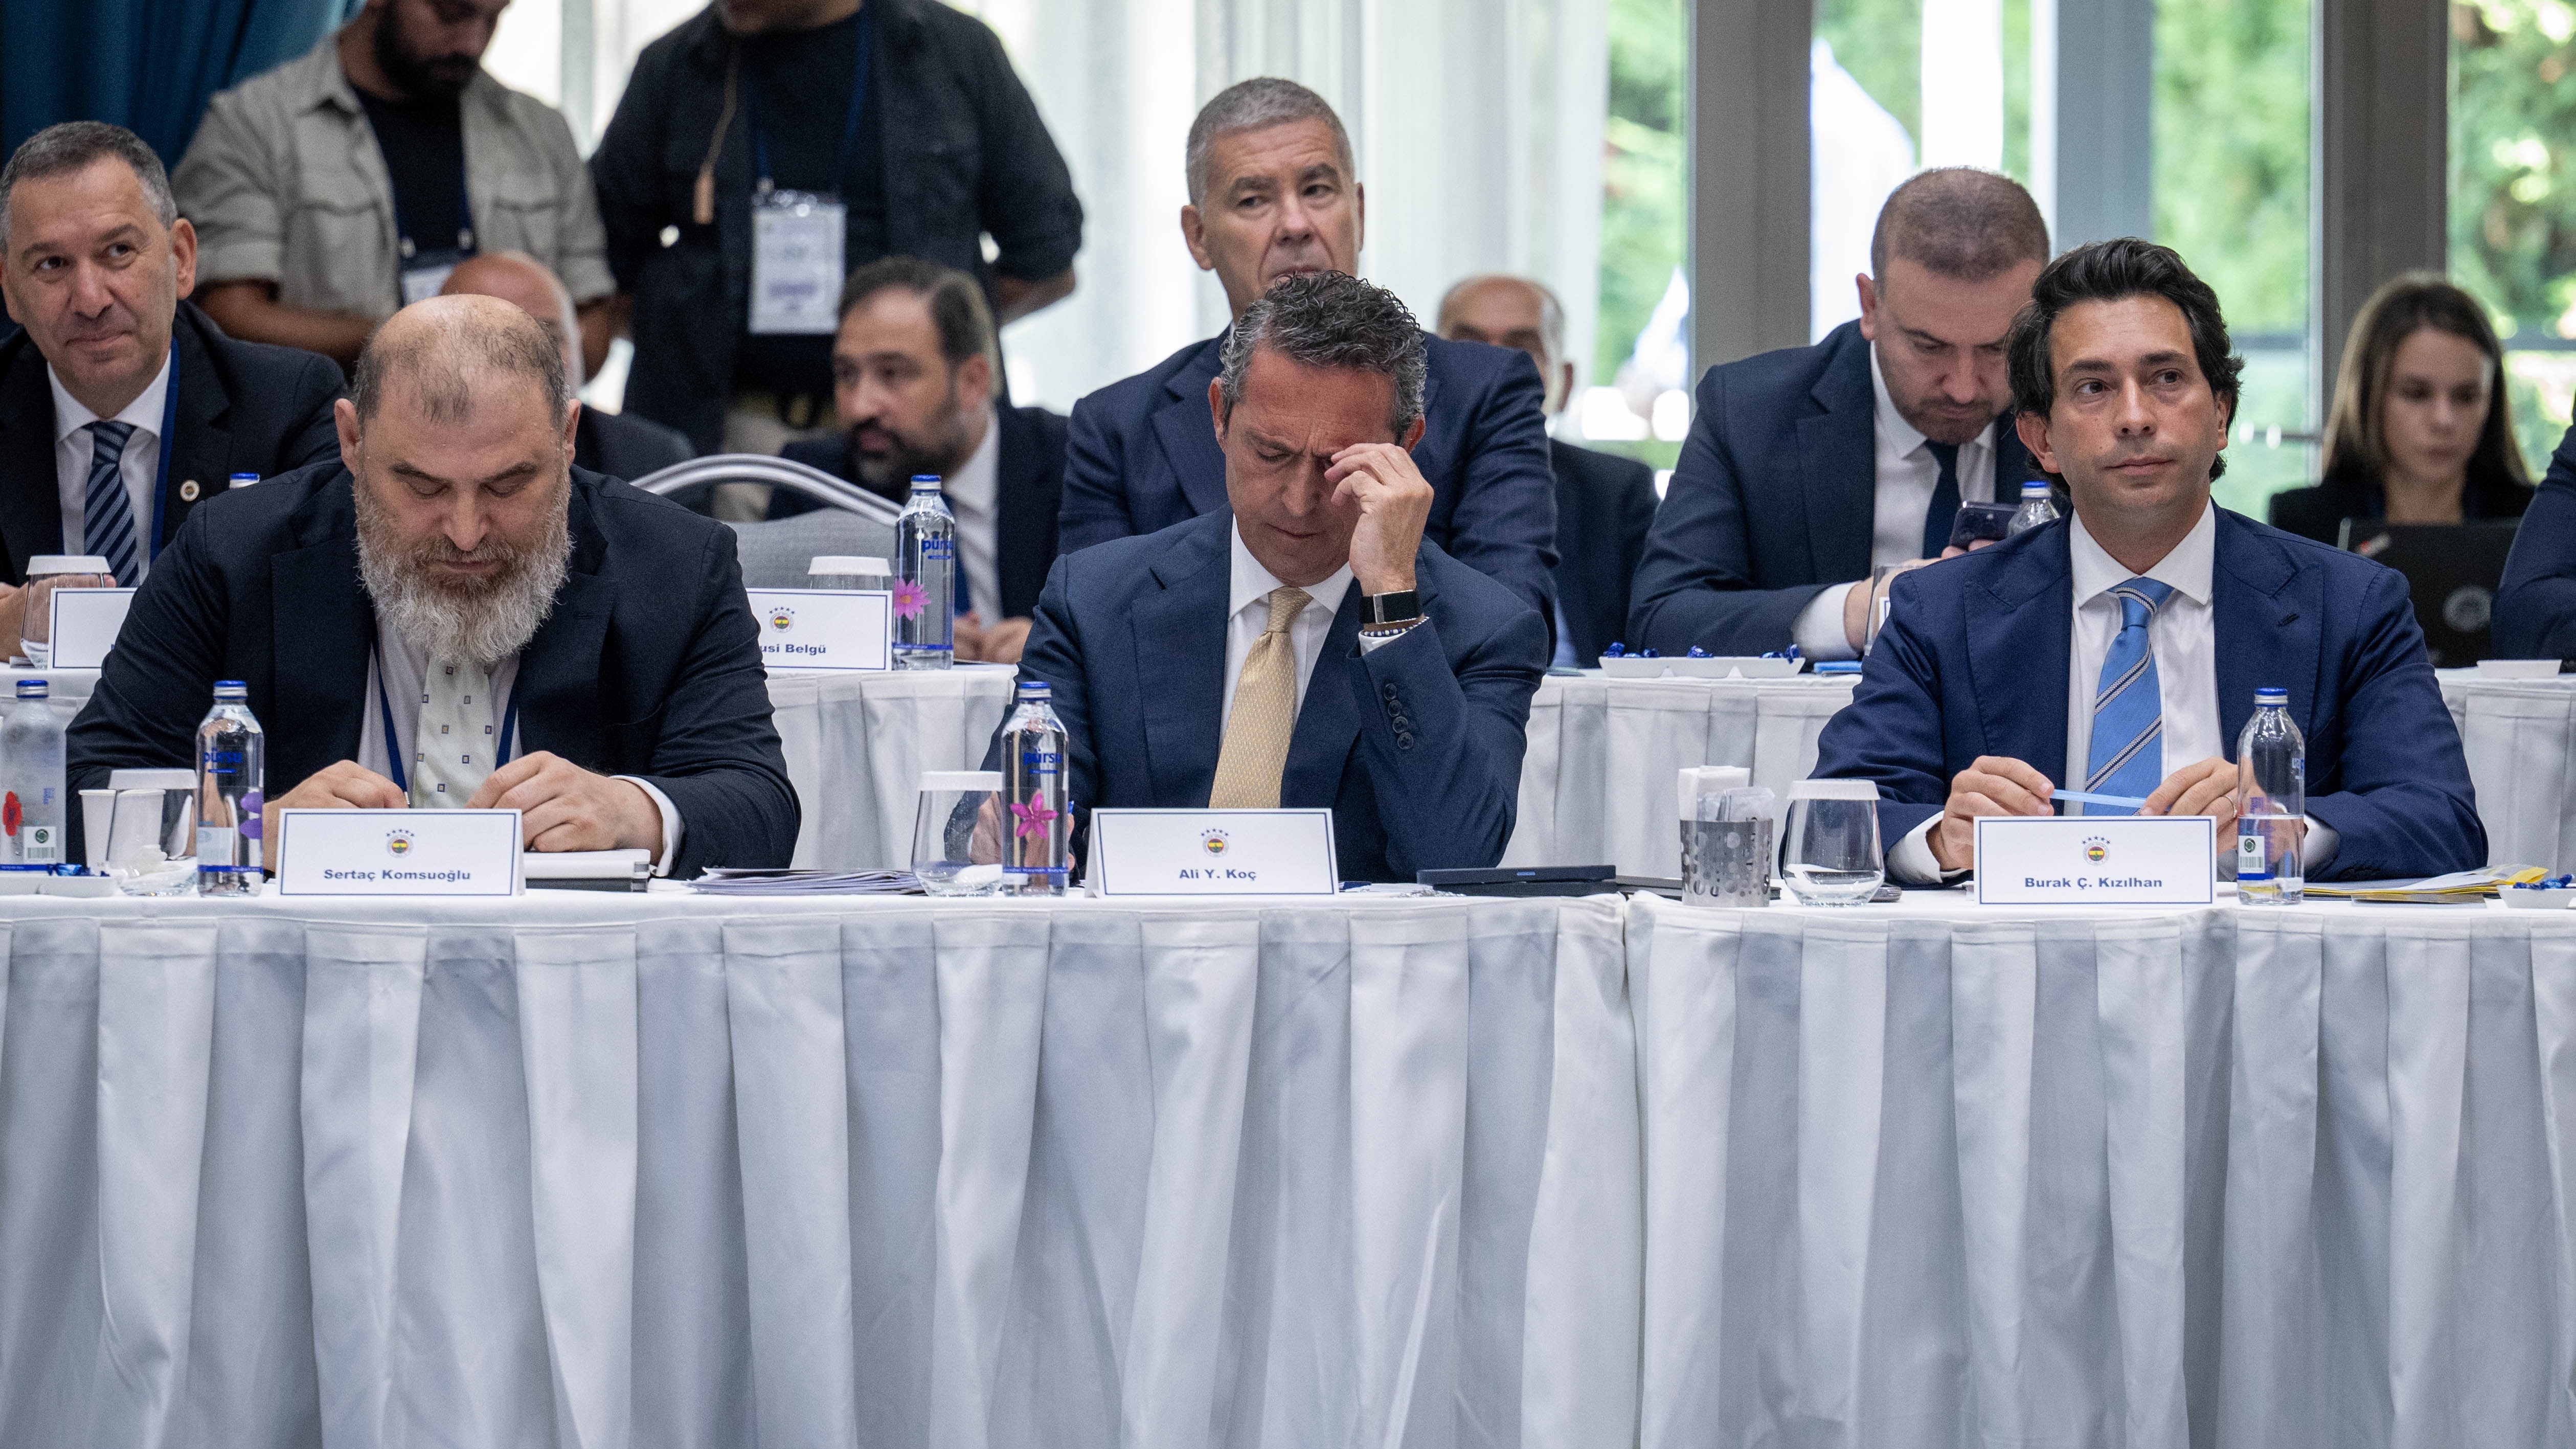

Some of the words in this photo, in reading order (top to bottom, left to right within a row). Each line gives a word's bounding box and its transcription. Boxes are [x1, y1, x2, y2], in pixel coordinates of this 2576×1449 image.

[759, 644, 780, 653] usi
[785, 644, 826, 655] Belgü
[323, 869, 376, 881] Sertaç
[381, 869, 471, 882] Komsuoğlu
[1179, 869, 1200, 879] Ali
[1204, 869, 1220, 879] Y.
[1226, 869, 1257, 881] Koç
[2024, 877, 2072, 888] Burak
[2077, 877, 2093, 890] Ç.
[2098, 877, 2162, 888] Kızılhan
